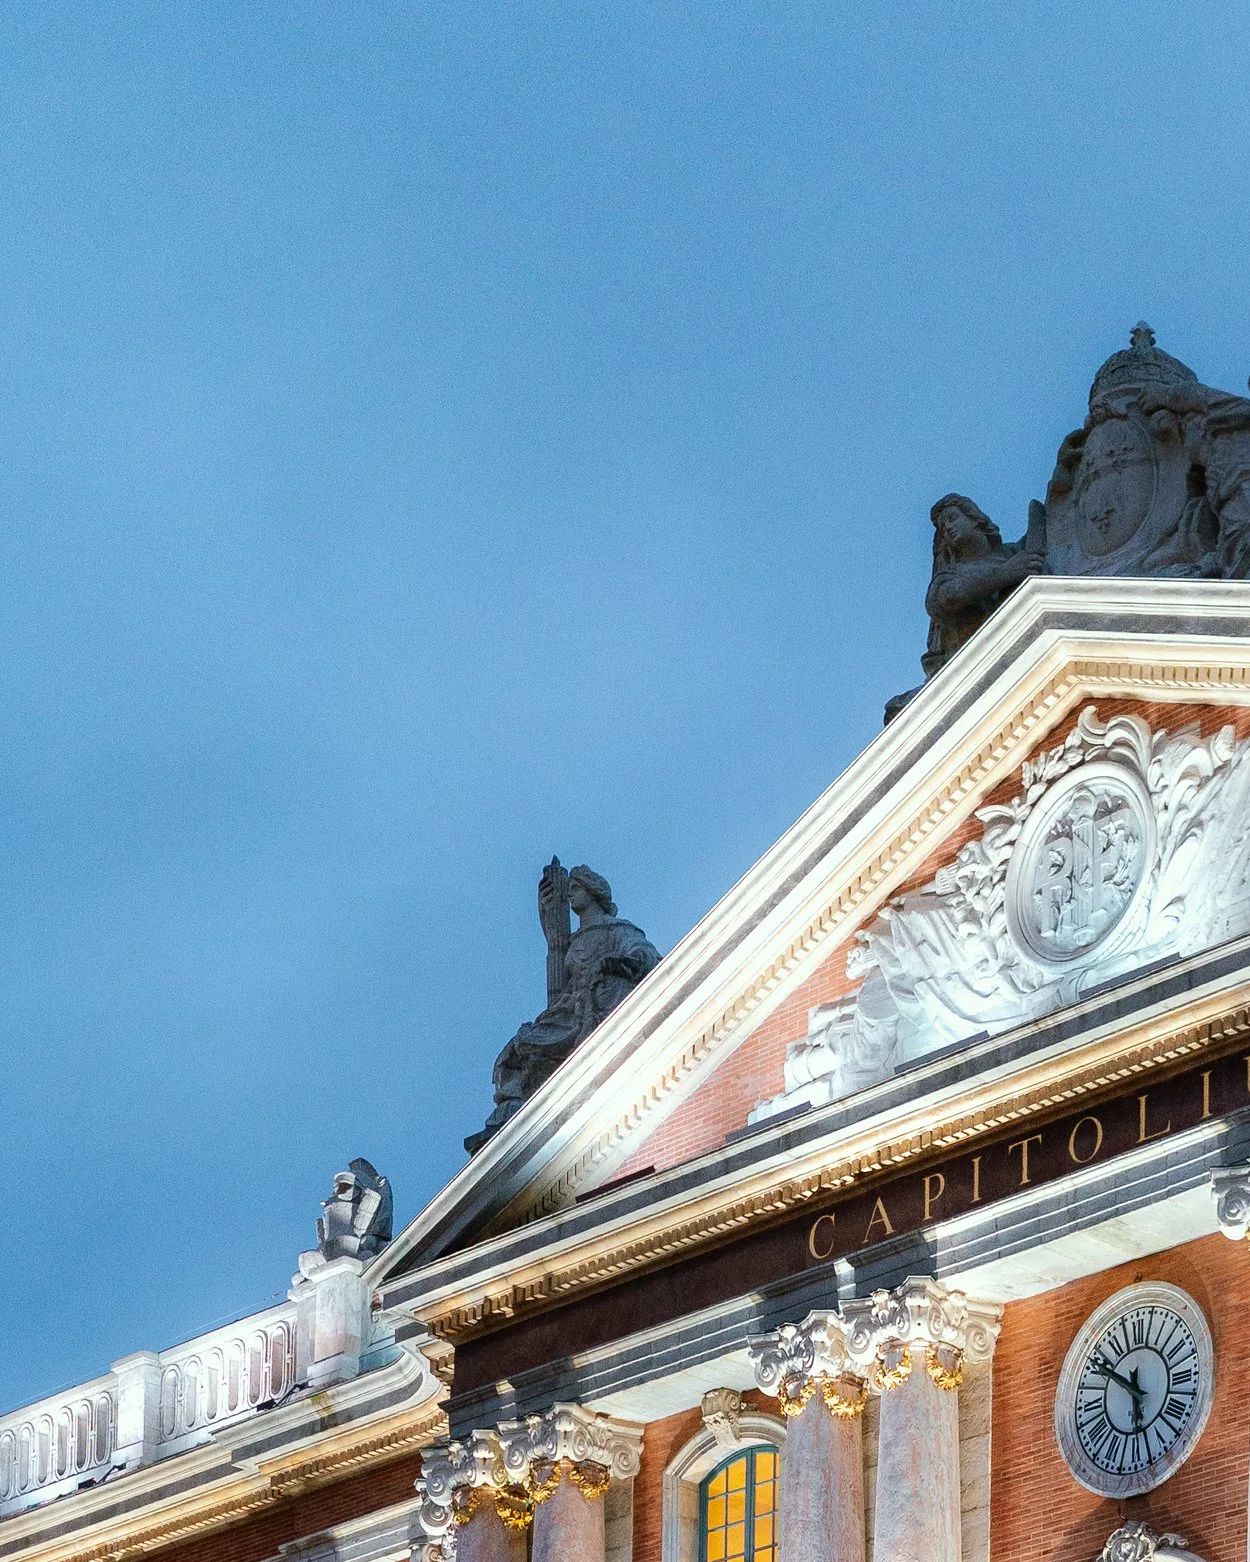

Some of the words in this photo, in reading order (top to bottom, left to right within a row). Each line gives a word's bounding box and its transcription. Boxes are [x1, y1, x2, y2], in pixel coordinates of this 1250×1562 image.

[1131, 1319, 1144, 1348] XII
[1154, 1320, 1167, 1346] I
[1108, 1335, 1124, 1361] XI
[1167, 1338, 1186, 1361] II
[1172, 1368, 1192, 1387] III
[1164, 1397, 1187, 1421] IIII
[1088, 1417, 1110, 1447] VIII
[1154, 1426, 1166, 1449] V
[1105, 1434, 1122, 1463] VII
